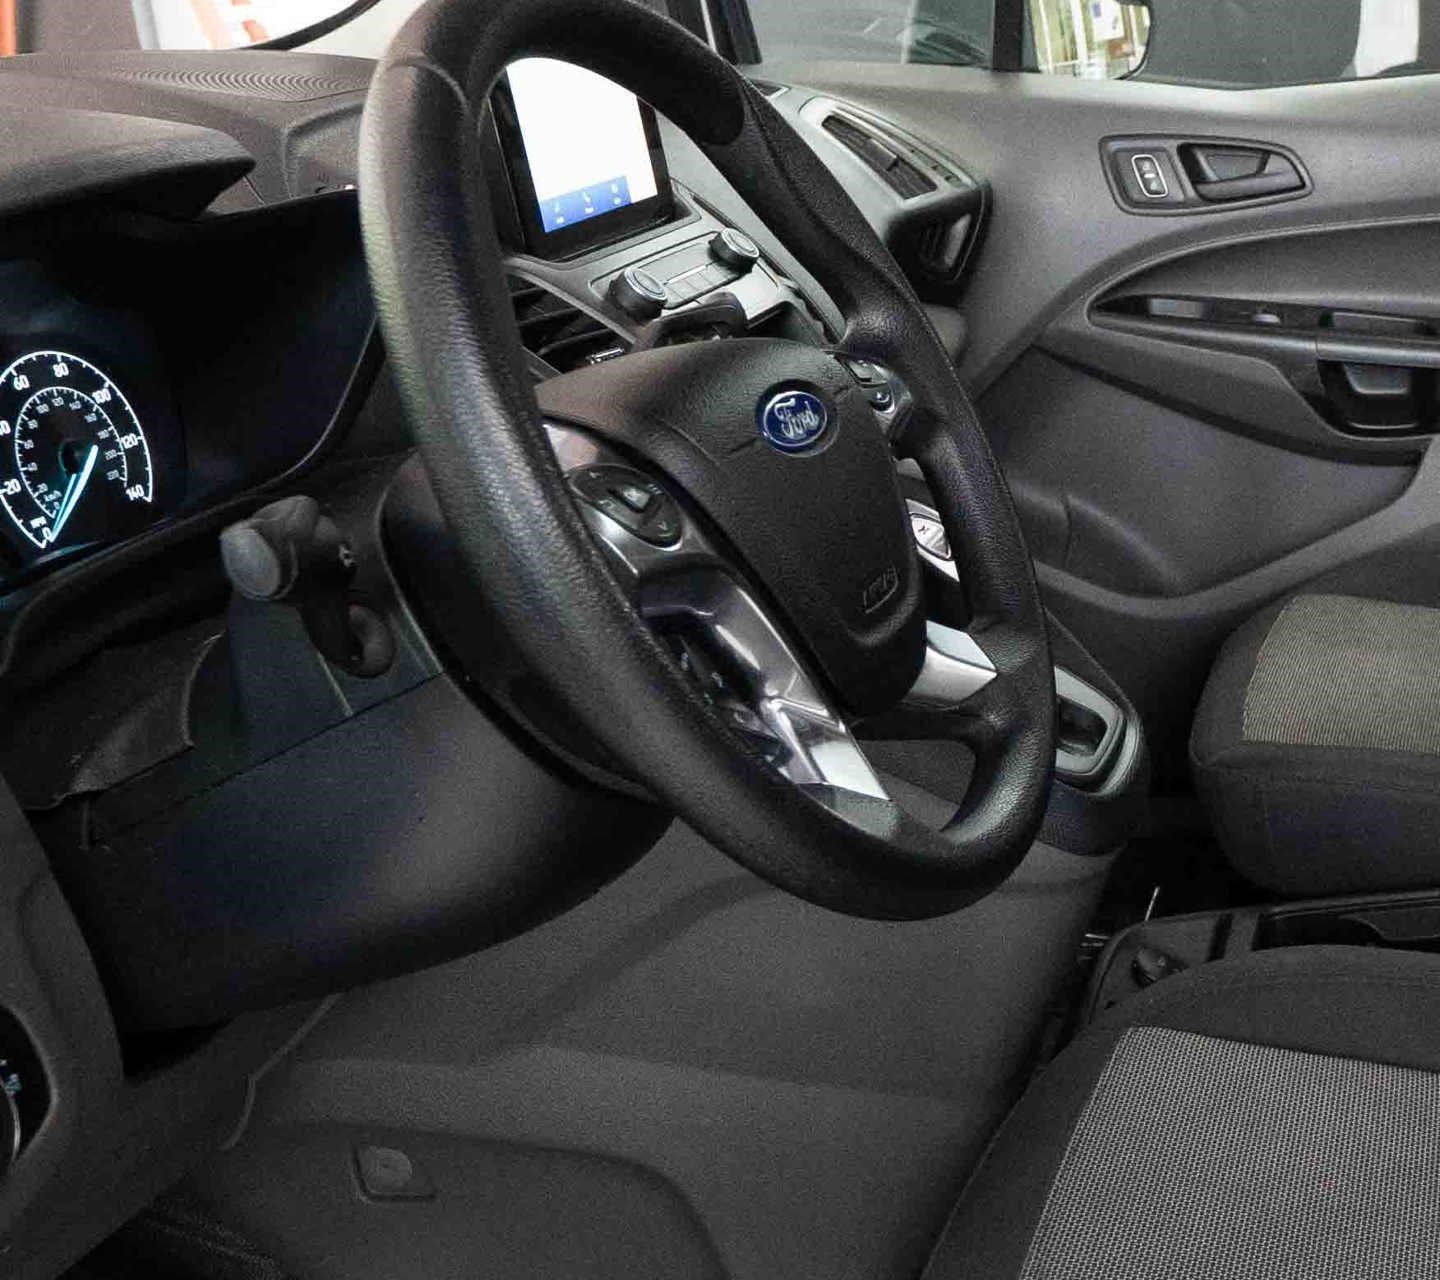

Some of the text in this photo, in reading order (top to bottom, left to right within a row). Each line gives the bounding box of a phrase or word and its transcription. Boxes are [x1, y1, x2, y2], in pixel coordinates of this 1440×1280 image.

[52, 362, 70, 378] 80
[13, 374, 30, 391] 60
[774, 397, 821, 440] Ford
[120, 433, 139, 450] 120
[4, 478, 22, 495] 20
[125, 484, 145, 501] 140
